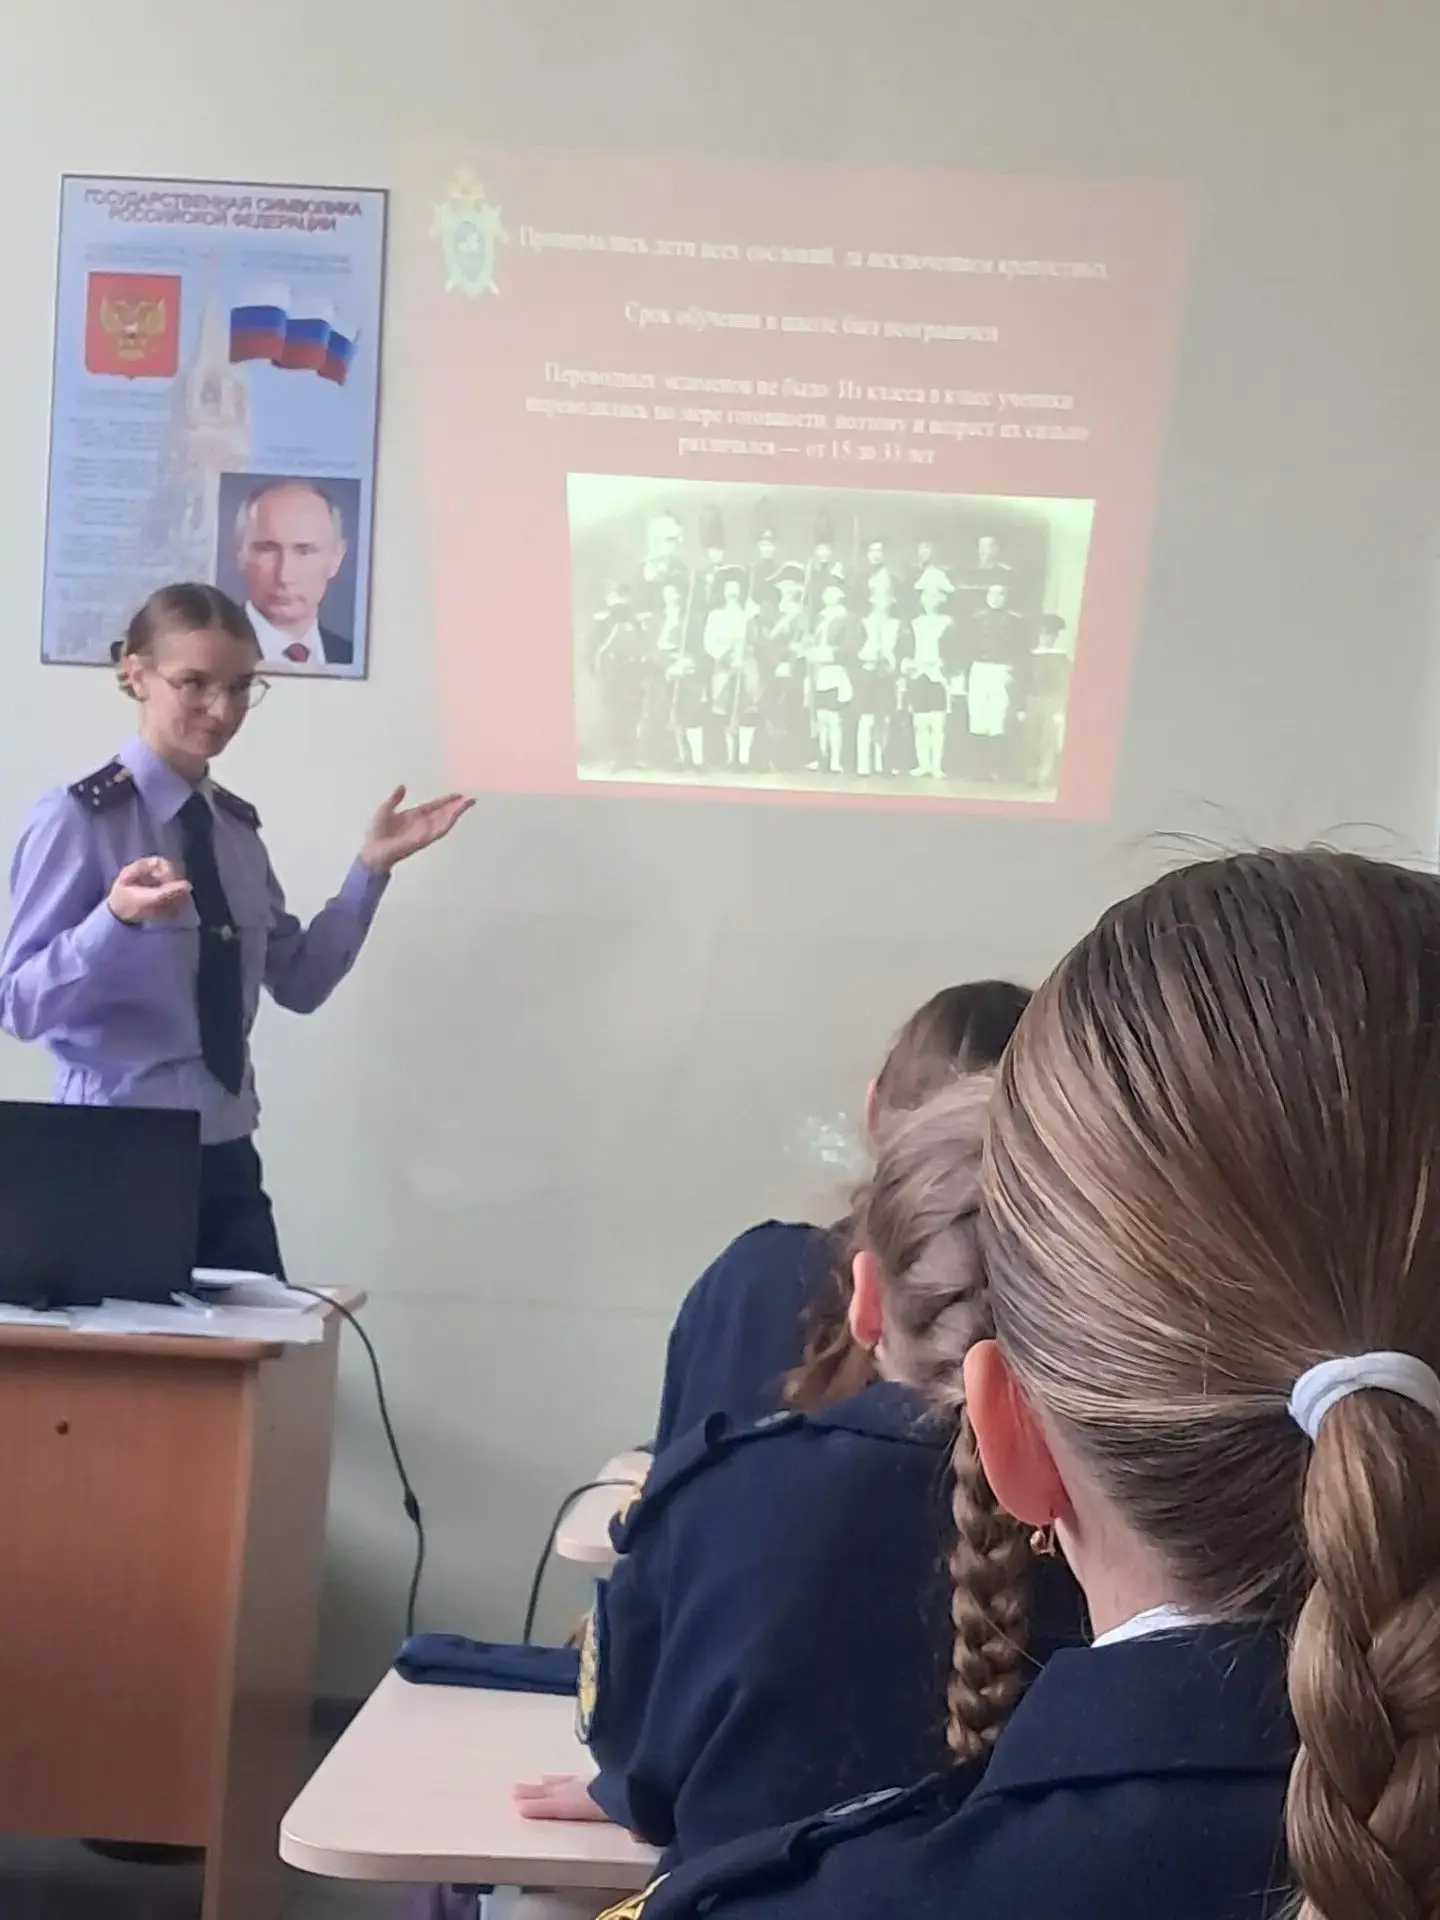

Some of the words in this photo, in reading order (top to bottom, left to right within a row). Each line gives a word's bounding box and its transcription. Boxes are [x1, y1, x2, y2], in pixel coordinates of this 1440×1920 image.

[85, 188, 252, 214] ГОСУДАРСТВЕННАЯ
[254, 196, 362, 217] СИМВОЛИКА
[109, 204, 227, 226] РОССИЙСКОЙ
[232, 212, 337, 232] ФЕДЕРАЦИИ
[624, 300, 671, 328] Срок
[676, 303, 761, 332] обучения
[832, 439, 851, 459] 15
